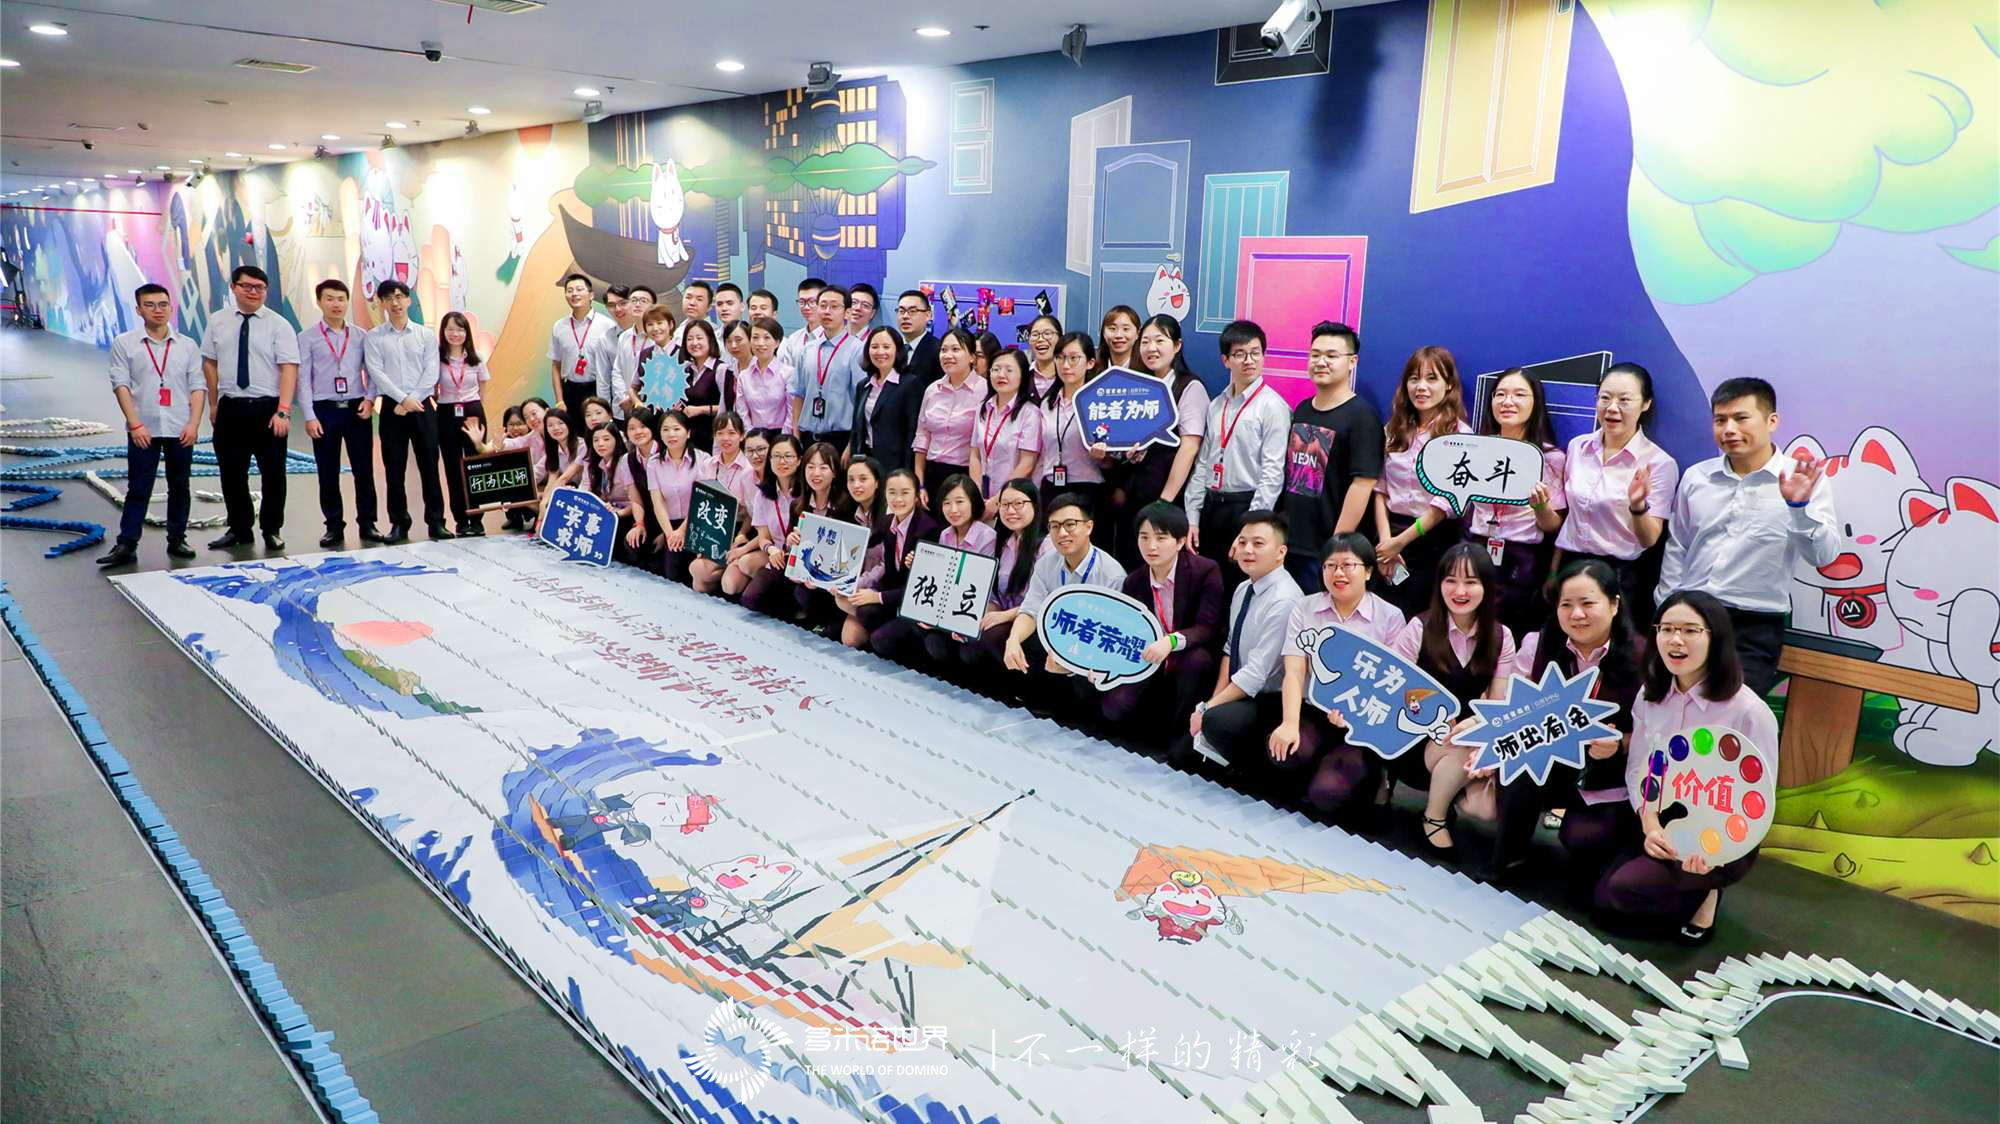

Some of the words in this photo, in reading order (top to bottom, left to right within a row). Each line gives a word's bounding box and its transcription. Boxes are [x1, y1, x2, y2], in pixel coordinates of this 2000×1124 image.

[1088, 400, 1160, 421] 能者为师
[471, 470, 528, 491] 行为人师
[1446, 451, 1516, 494] 奋斗
[697, 500, 728, 536] 改变
[816, 525, 837, 545] 梦想
[912, 575, 978, 621] 独立
[1050, 608, 1147, 663] 师者荣耀
[1352, 649, 1406, 695] 乐为
[1333, 685, 1391, 726] 人师
[1494, 705, 1592, 761] 师出有名
[1671, 768, 1736, 813] 价值
